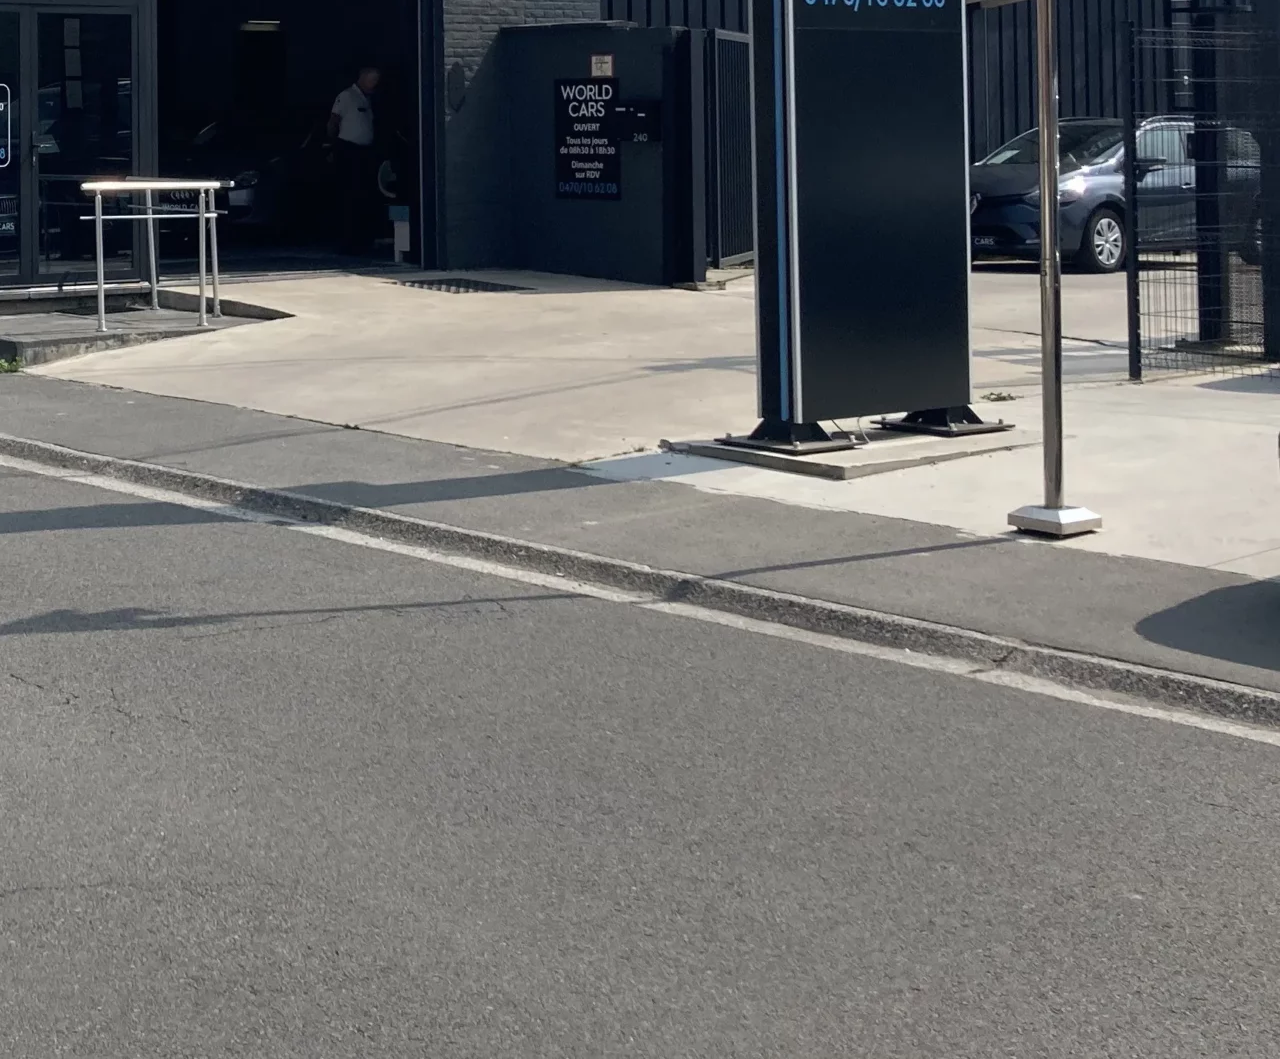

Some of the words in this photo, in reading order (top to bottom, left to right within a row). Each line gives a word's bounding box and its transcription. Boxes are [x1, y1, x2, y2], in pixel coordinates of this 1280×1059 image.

[561, 85, 613, 100] WORLD
[568, 102, 605, 117] CARS
[573, 123, 600, 131] OUVERT
[633, 133, 648, 142] 240
[571, 160, 604, 169] Dimanche
[586, 170, 600, 179] RDV
[974, 237, 994, 246] CARS
